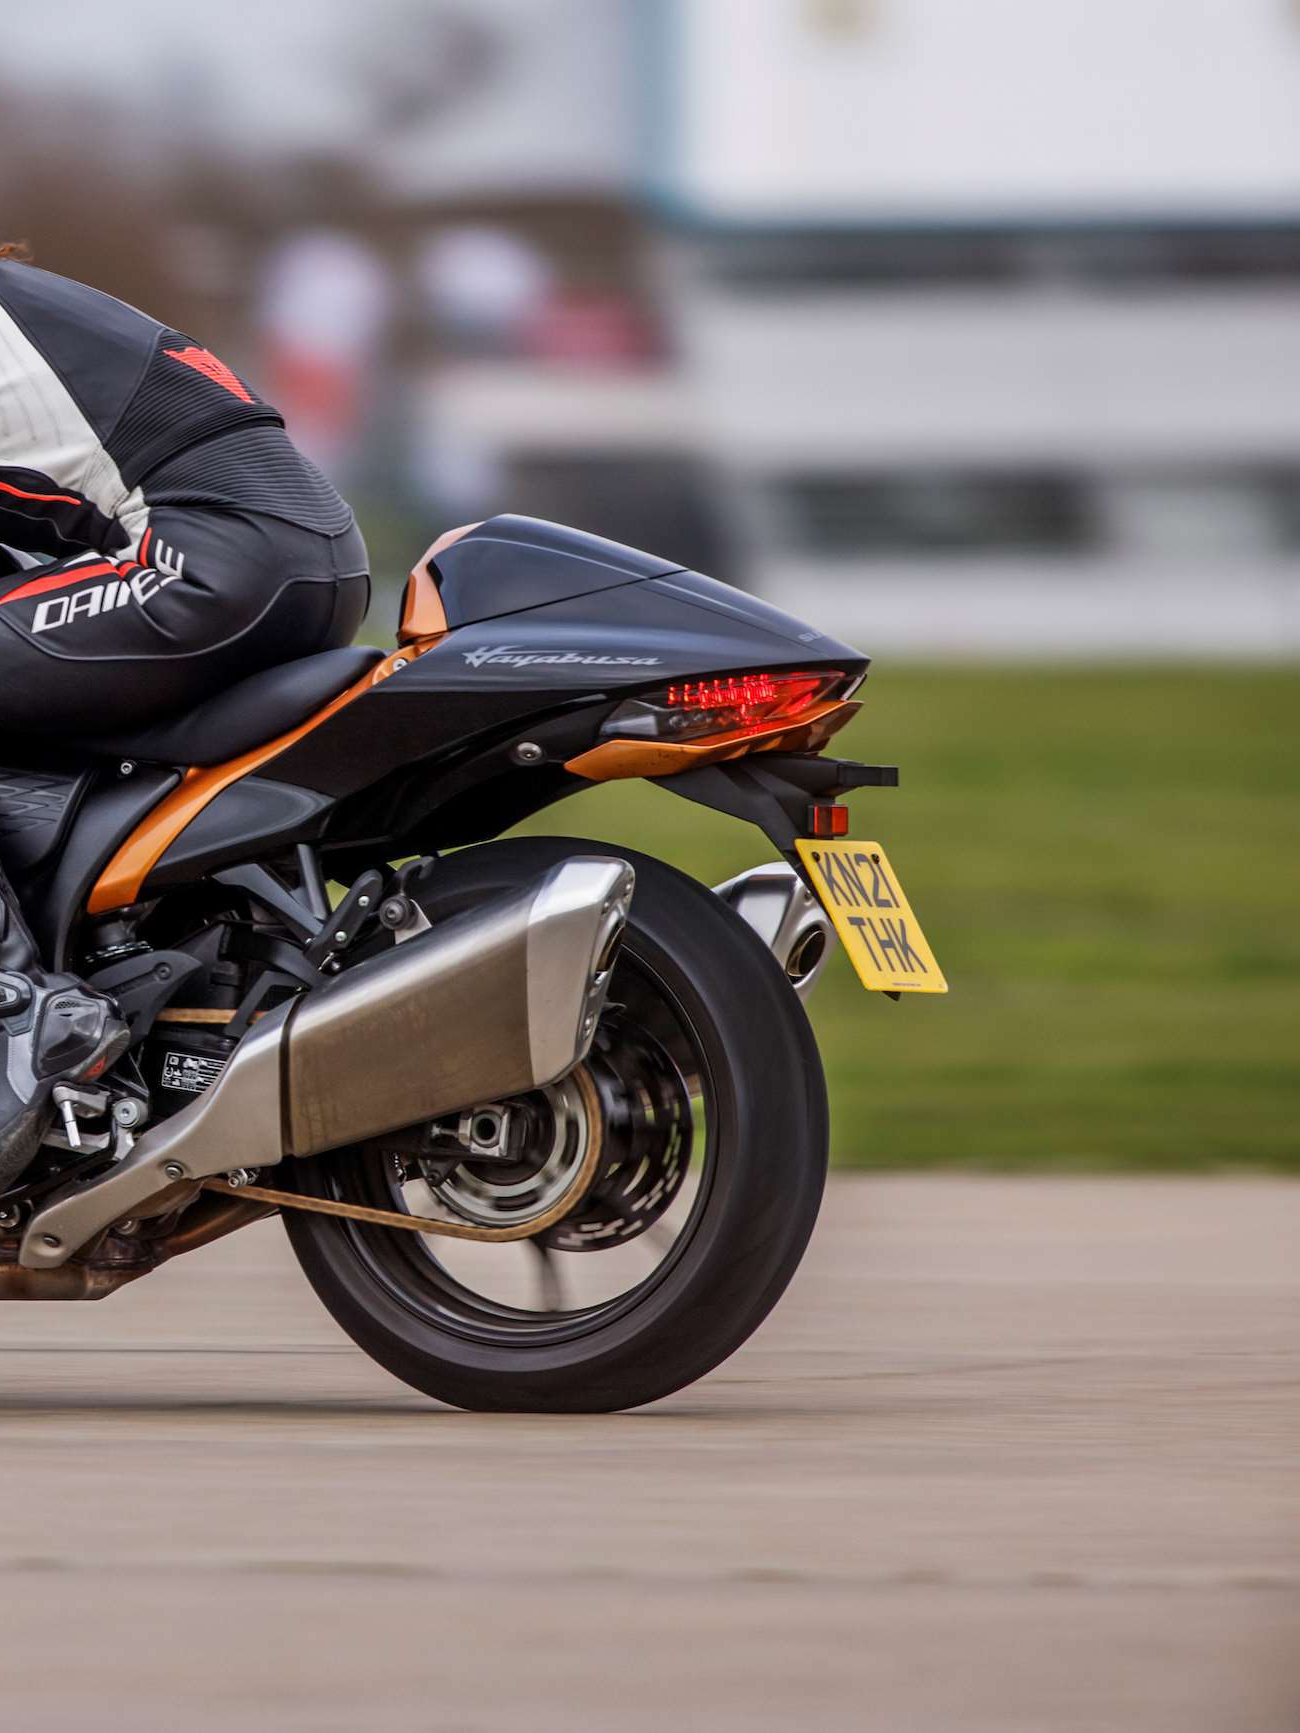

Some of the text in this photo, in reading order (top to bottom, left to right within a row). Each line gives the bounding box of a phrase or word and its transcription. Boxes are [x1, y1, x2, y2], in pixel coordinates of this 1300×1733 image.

[462, 645, 664, 668] Hayabusa
[812, 852, 900, 908] KN21
[847, 916, 928, 973] THK
